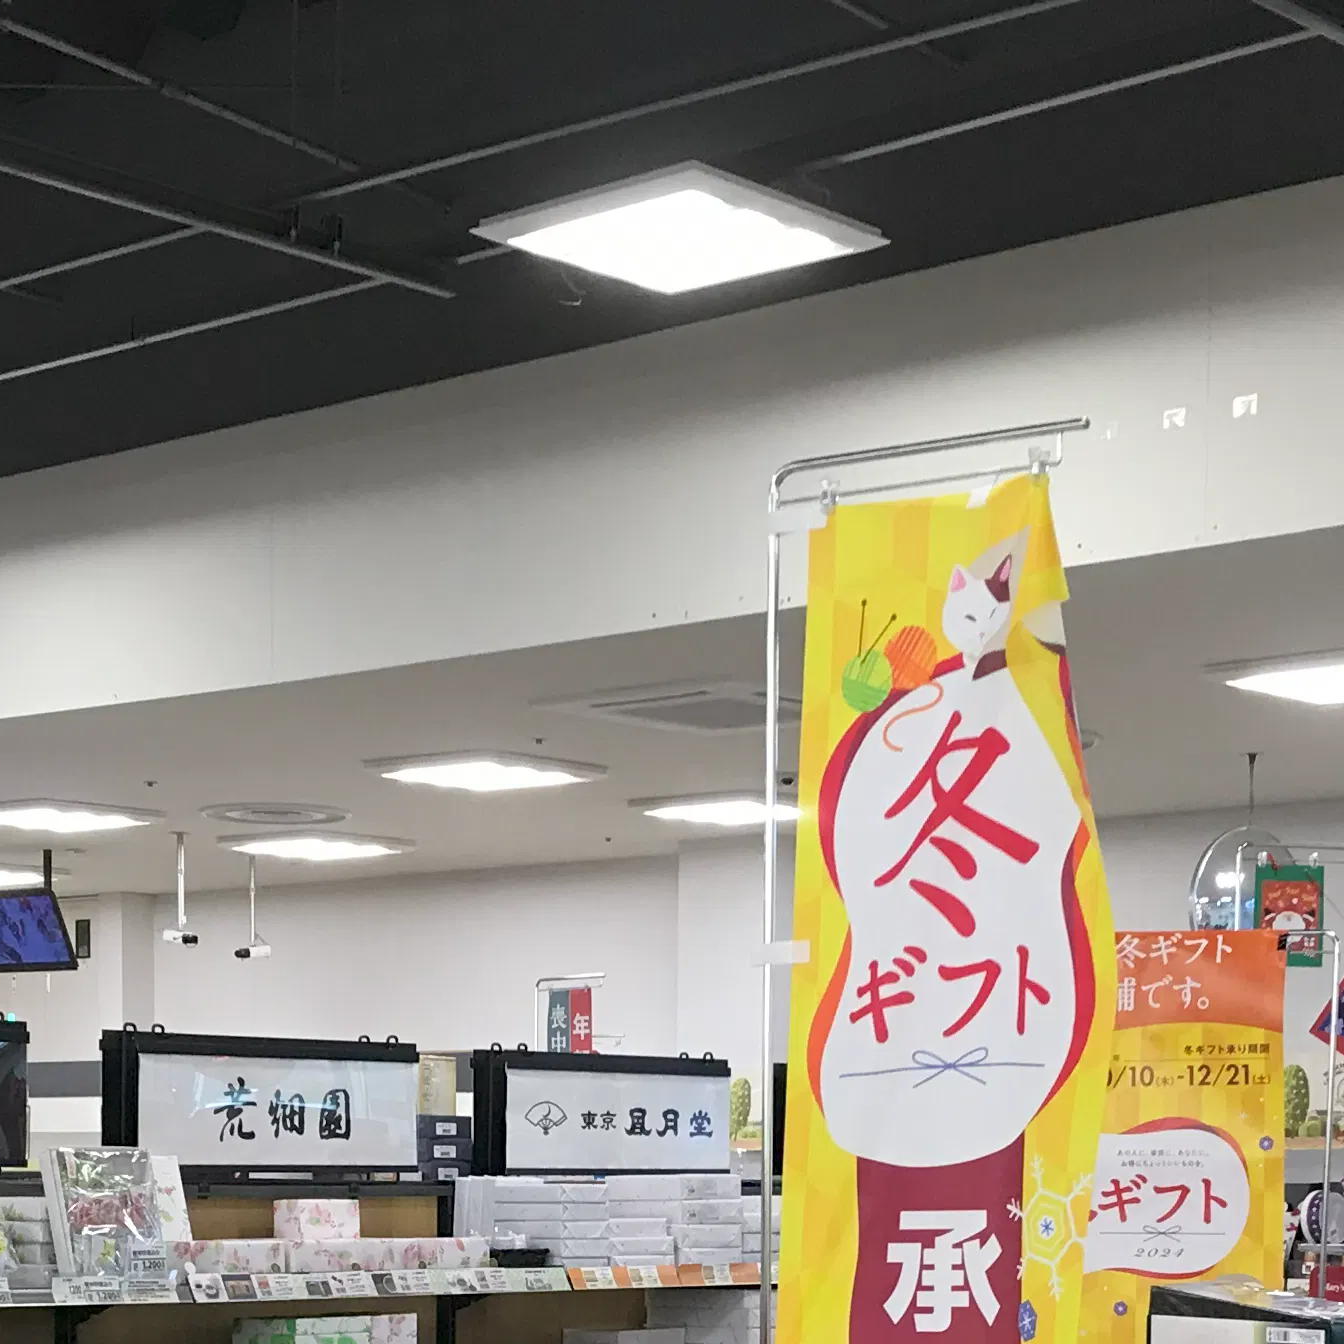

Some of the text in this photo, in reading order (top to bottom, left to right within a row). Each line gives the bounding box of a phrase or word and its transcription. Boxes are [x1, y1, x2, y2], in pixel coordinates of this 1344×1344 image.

[874, 710, 1039, 937] 冬
[1115, 933, 1232, 968] 冬ギフト
[849, 945, 1050, 1043] ギフト
[1184, 1044, 1270, 1054] 冬ギフト承り期間
[213, 1076, 352, 1142] 荒畑園
[581, 1110, 616, 1131] 東京
[1089, 1174, 1228, 1224] ギフト
[1134, 1248, 1184, 1257] 2024
